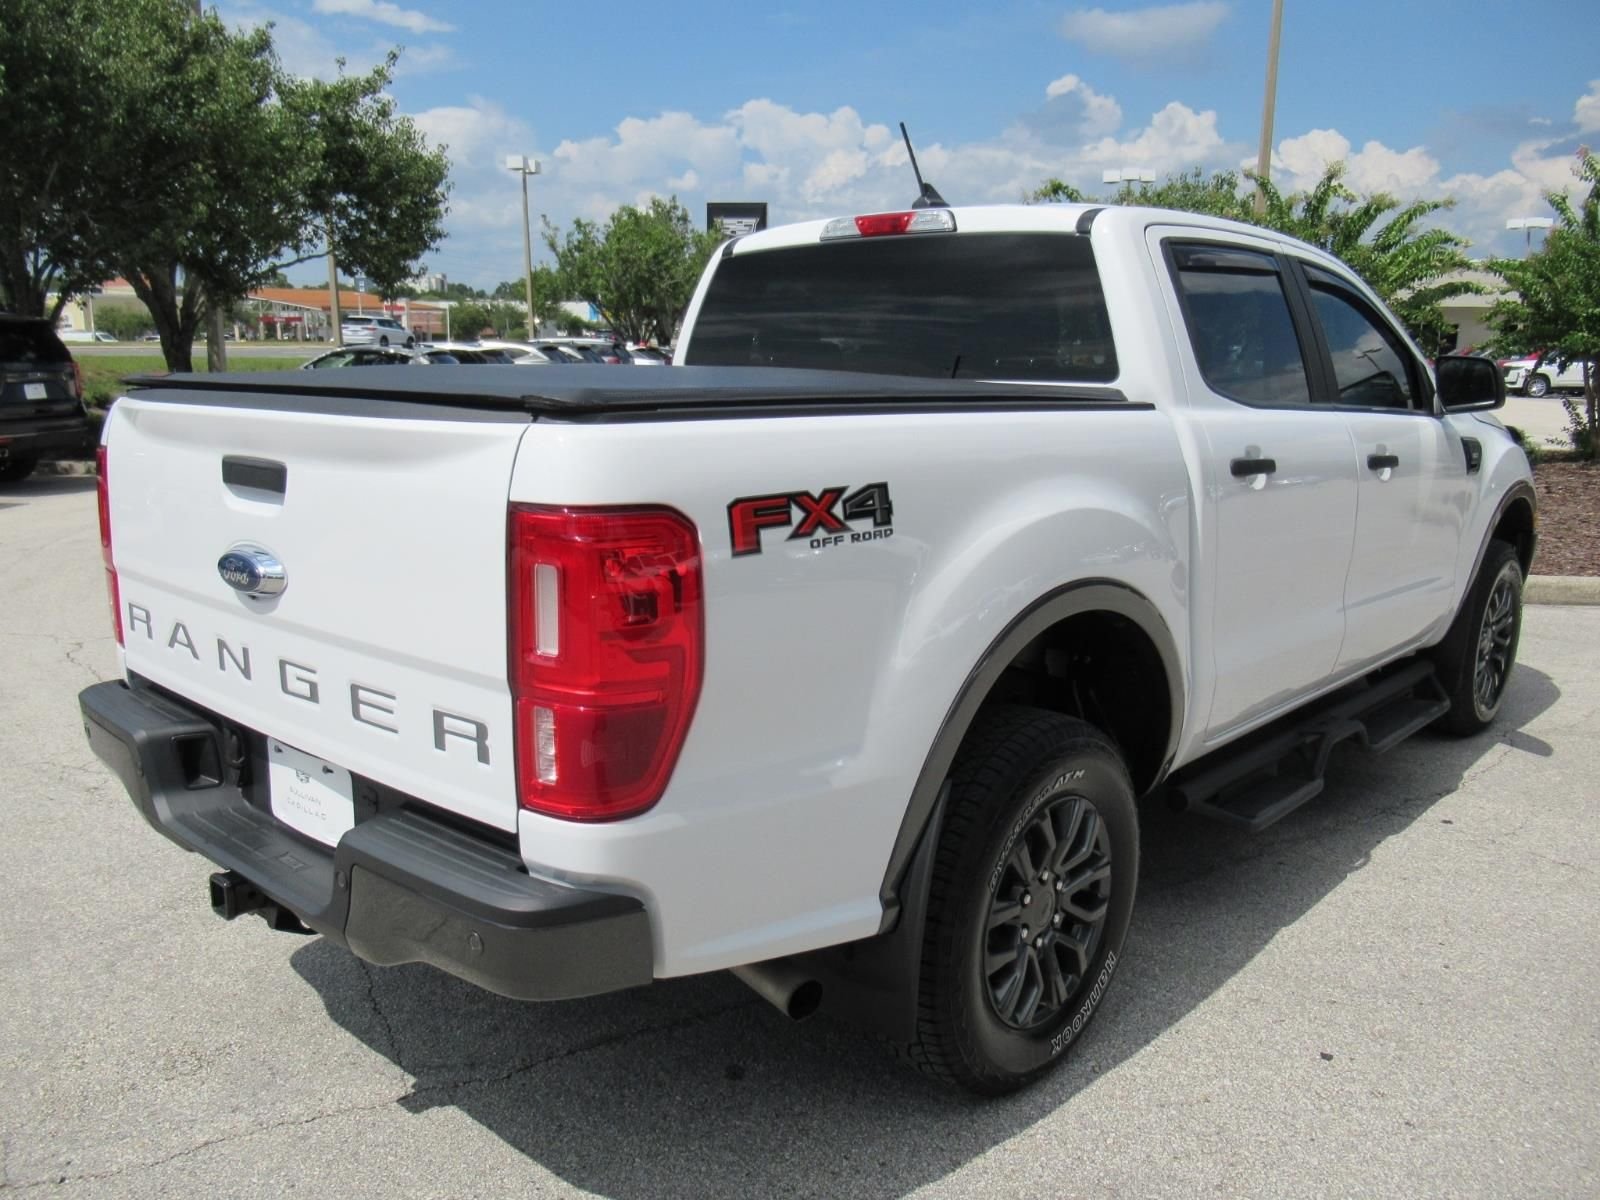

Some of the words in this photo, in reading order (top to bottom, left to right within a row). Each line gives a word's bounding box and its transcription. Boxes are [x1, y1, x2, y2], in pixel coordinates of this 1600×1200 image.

[727, 481, 894, 559] FX4
[810, 535, 845, 549] OFF
[850, 528, 894, 543] ROAD
[128, 602, 492, 766] RANGER
